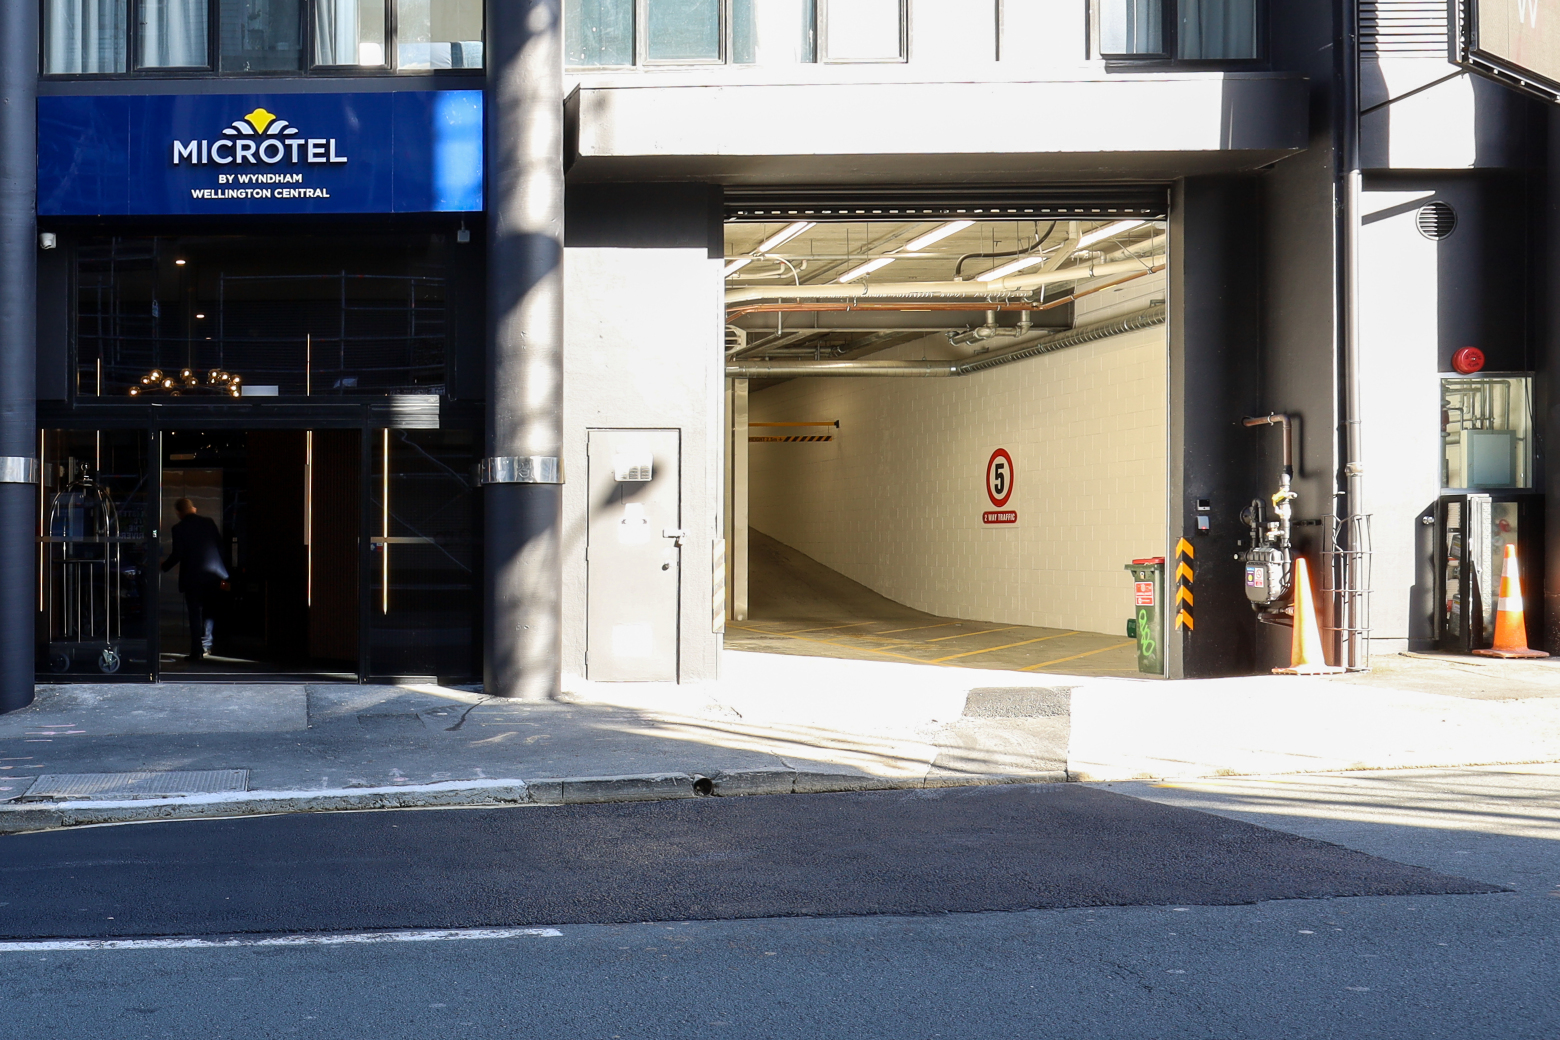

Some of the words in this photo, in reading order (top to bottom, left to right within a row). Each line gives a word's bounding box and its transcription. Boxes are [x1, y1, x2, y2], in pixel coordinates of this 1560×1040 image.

[173, 138, 348, 164] MICROTEL
[218, 174, 234, 184] BY
[238, 173, 303, 184] WYNDHAM
[191, 189, 271, 199] WELLINGTON
[274, 188, 330, 198] CENTRAL
[994, 462, 1005, 495] 5
[988, 513, 997, 522] WAY
[997, 512, 1016, 521] TRAFFIC
